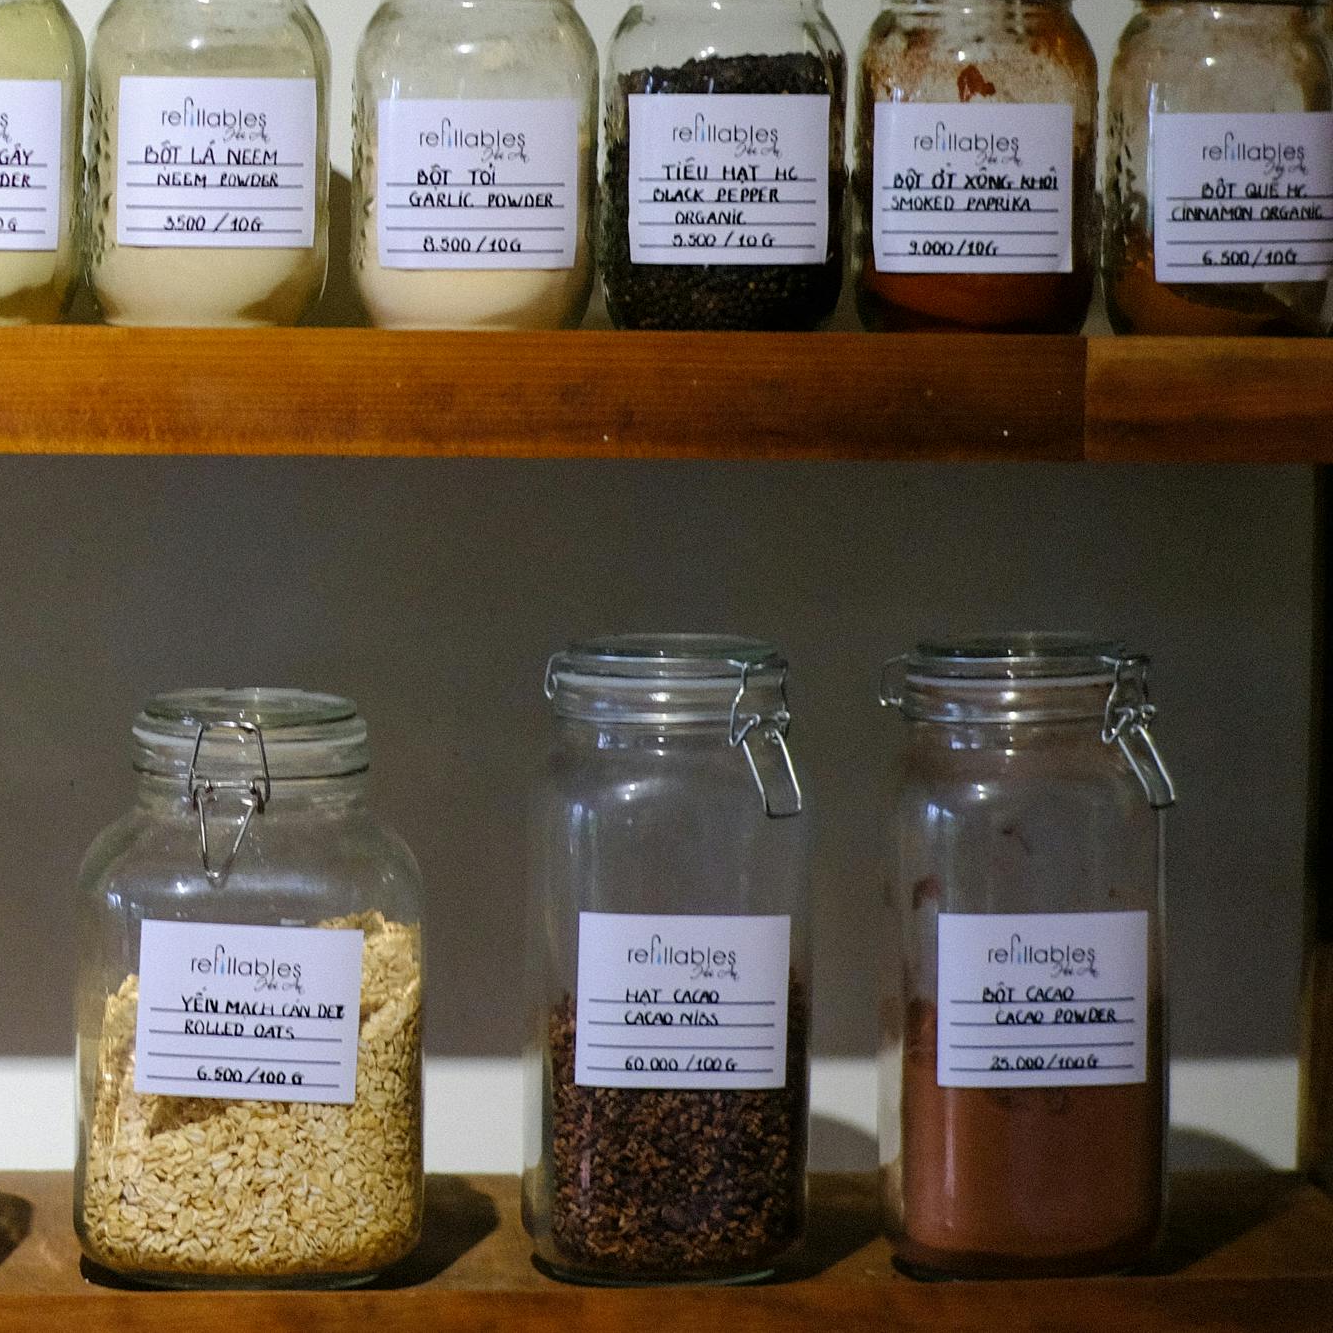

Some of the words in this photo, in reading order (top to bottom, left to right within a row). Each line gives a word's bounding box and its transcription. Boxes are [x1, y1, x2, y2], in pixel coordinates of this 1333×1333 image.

[163, 97, 266, 127] refillables
[420, 118, 525, 147] refillables
[673, 113, 778, 142] refillables
[914, 121, 1018, 151] refillables
[1203, 132, 1305, 160] refillables
[228, 150, 277, 165] NEEM
[157, 172, 206, 186] NEEM
[220, 174, 278, 187] POWDER
[775, 167, 798, 180] HC
[654, 188, 705, 201] BLACK
[715, 189, 779, 201] PEPPER
[1287, 186, 1306, 197] HC
[488, 193, 553, 207] POWDER
[892, 196, 953, 211] SMOKED
[628, 935, 736, 966] refillables
[988, 934, 1095, 964] refillables
[191, 944, 301, 978] refillables
[674, 989, 719, 1003] CACAO
[1026, 987, 1074, 1001] CACAO
[625, 1011, 673, 1025] CACAO
[996, 1009, 1044, 1024] CACAO
[1054, 1008, 1116, 1023] POWDER
[184, 1020, 244, 1036] ROLLED
[255, 1025, 294, 1039] OATS
